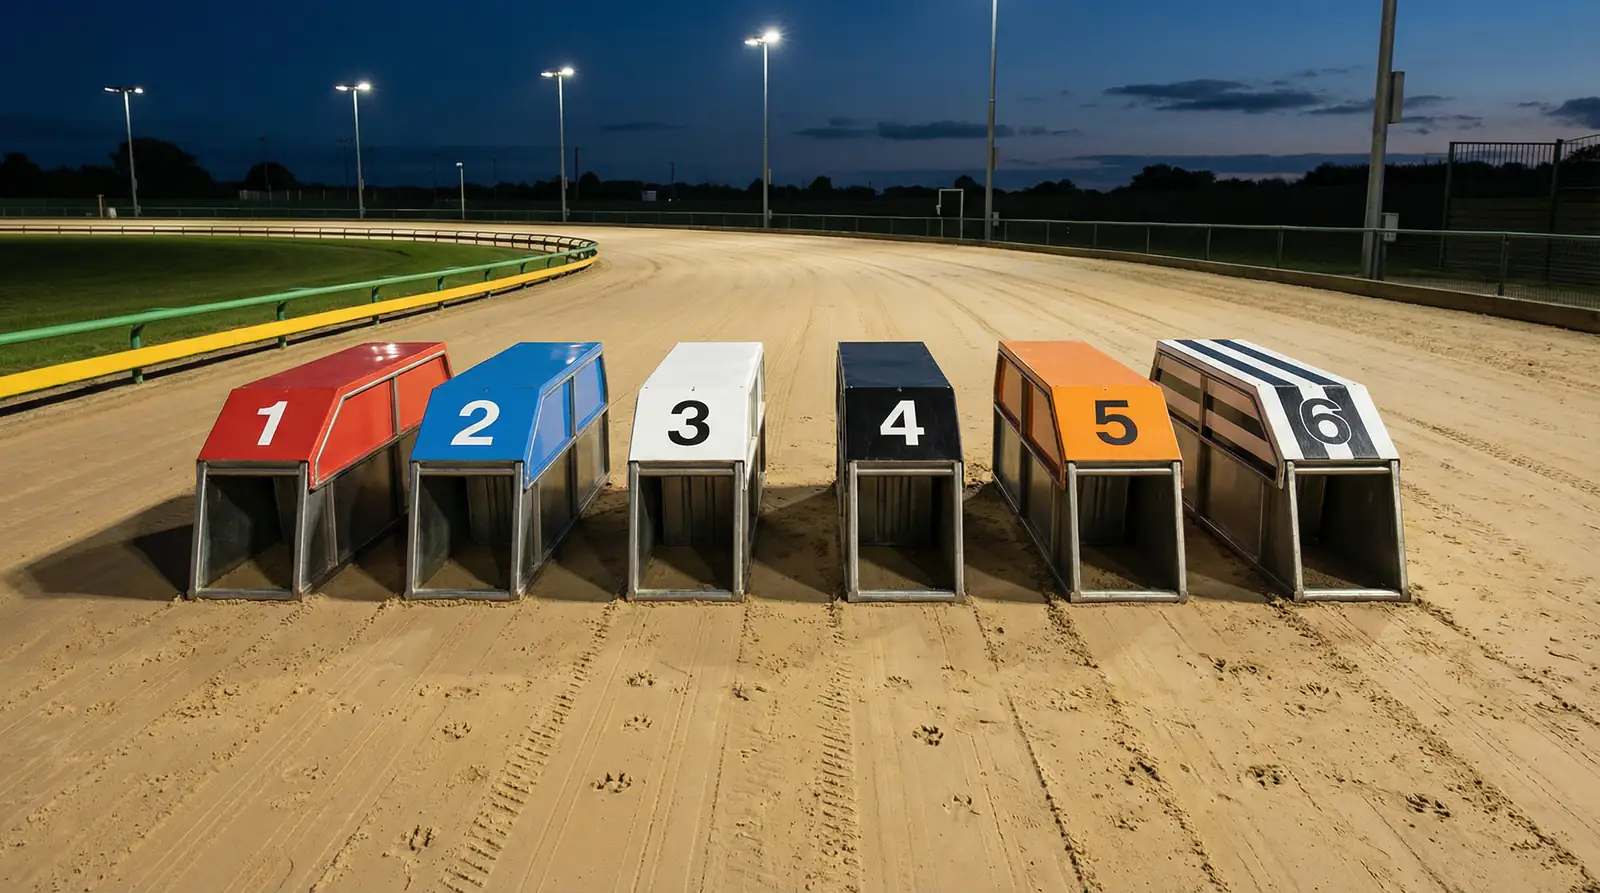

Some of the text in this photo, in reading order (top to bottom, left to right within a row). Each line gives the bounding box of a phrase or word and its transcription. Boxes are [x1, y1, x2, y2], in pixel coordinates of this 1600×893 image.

[257, 400, 288, 446] 1
[450, 400, 500, 446] 2
[667, 400, 710, 446] 3
[879, 400, 925, 446] 4
[1095, 400, 1138, 446] 5
[1299, 397, 1352, 446] 6
